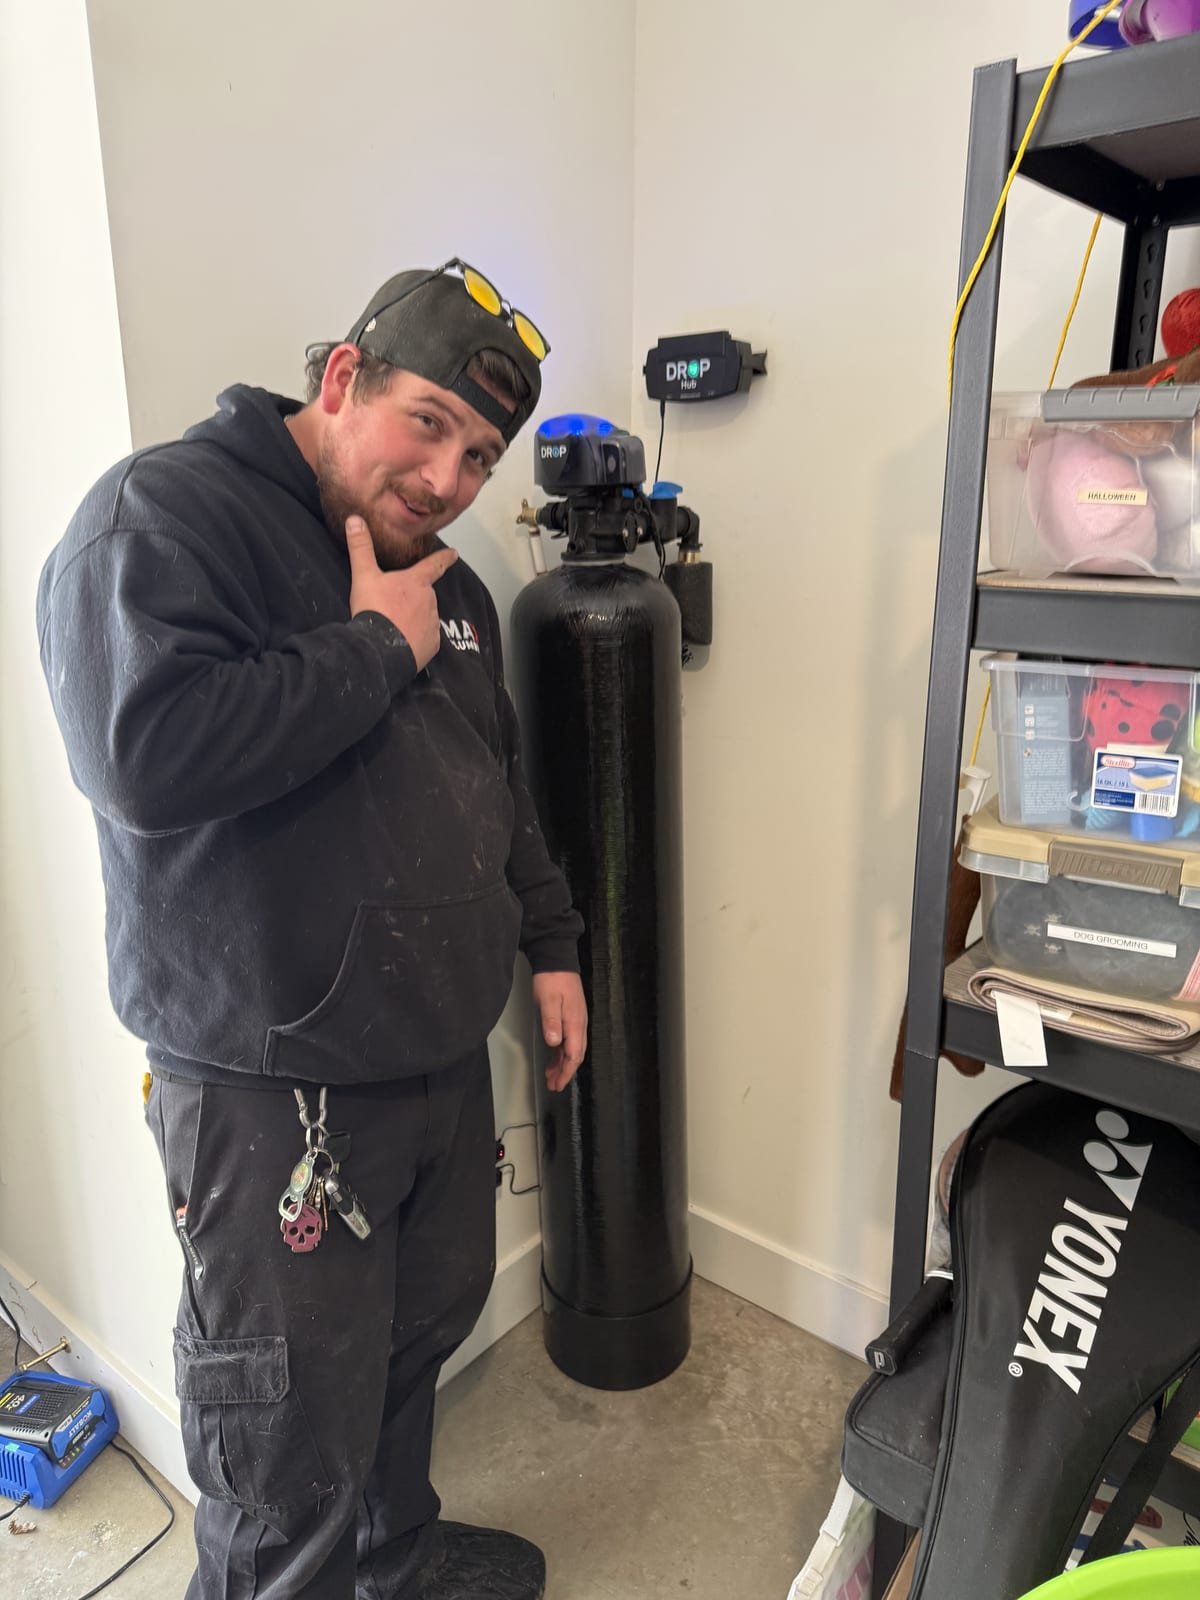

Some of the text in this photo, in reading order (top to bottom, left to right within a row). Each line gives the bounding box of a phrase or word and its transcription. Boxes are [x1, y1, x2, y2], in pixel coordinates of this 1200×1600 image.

[666, 358, 711, 382] DROP
[681, 379, 697, 390] Hub
[541, 445, 567, 459] DROP
[1088, 491, 1136, 501] HALLOWEEN
[1073, 931, 1149, 950] DOG GROOMING
[1013, 1197, 1128, 1394] YONEX
[68, 1409, 93, 1438] KOBALT
